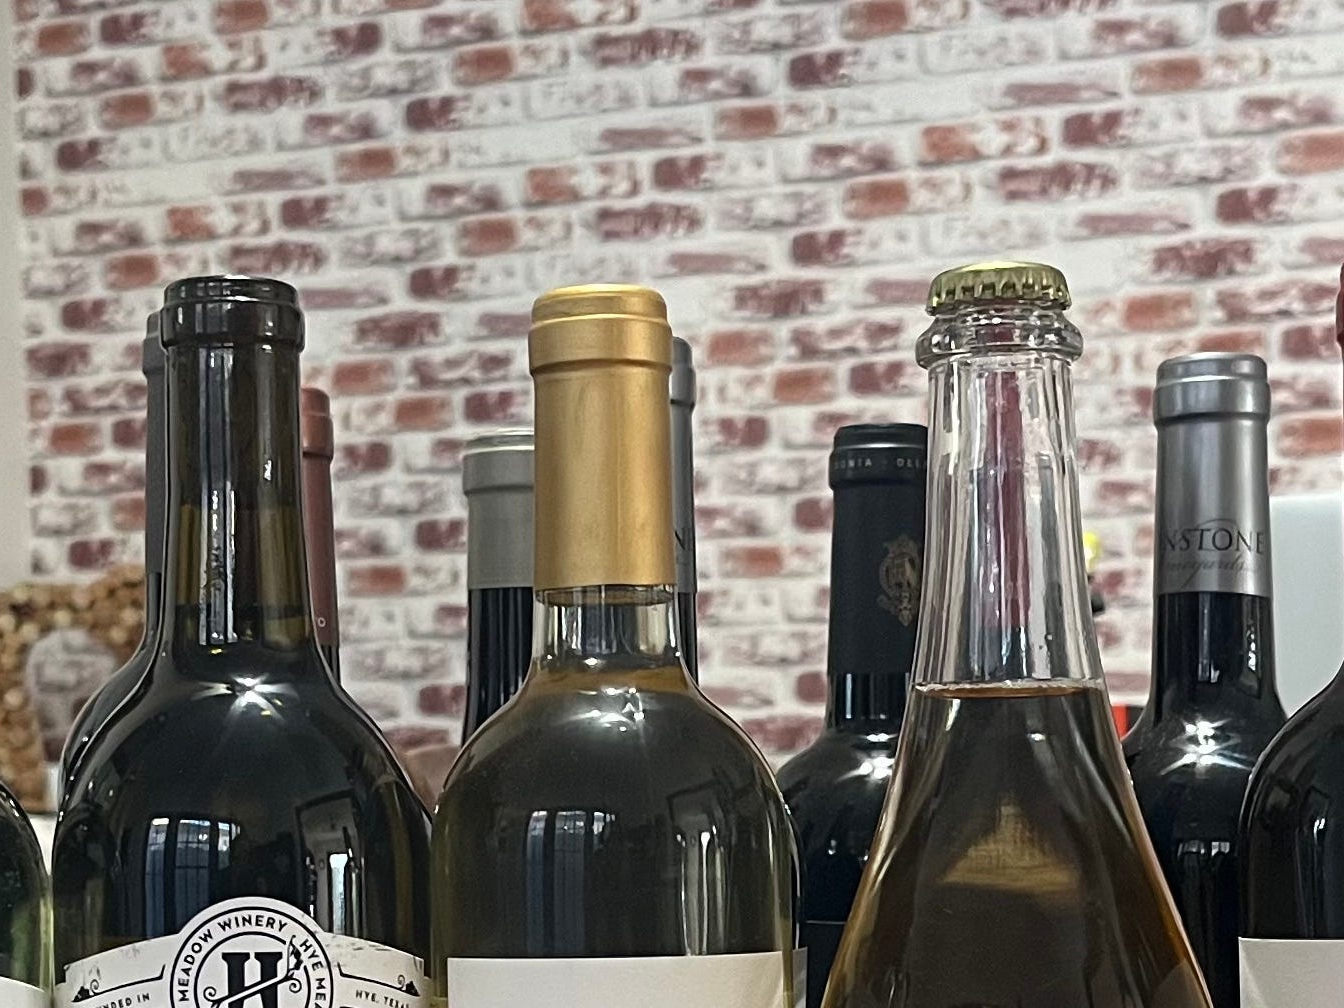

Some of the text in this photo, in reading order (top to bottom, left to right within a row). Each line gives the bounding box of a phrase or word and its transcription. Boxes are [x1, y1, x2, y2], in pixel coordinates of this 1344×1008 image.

[177, 928, 214, 1002] MEADOW
[217, 914, 288, 932] WINERY
[299, 938, 325, 972] HYE
[137, 992, 150, 1003] IN
